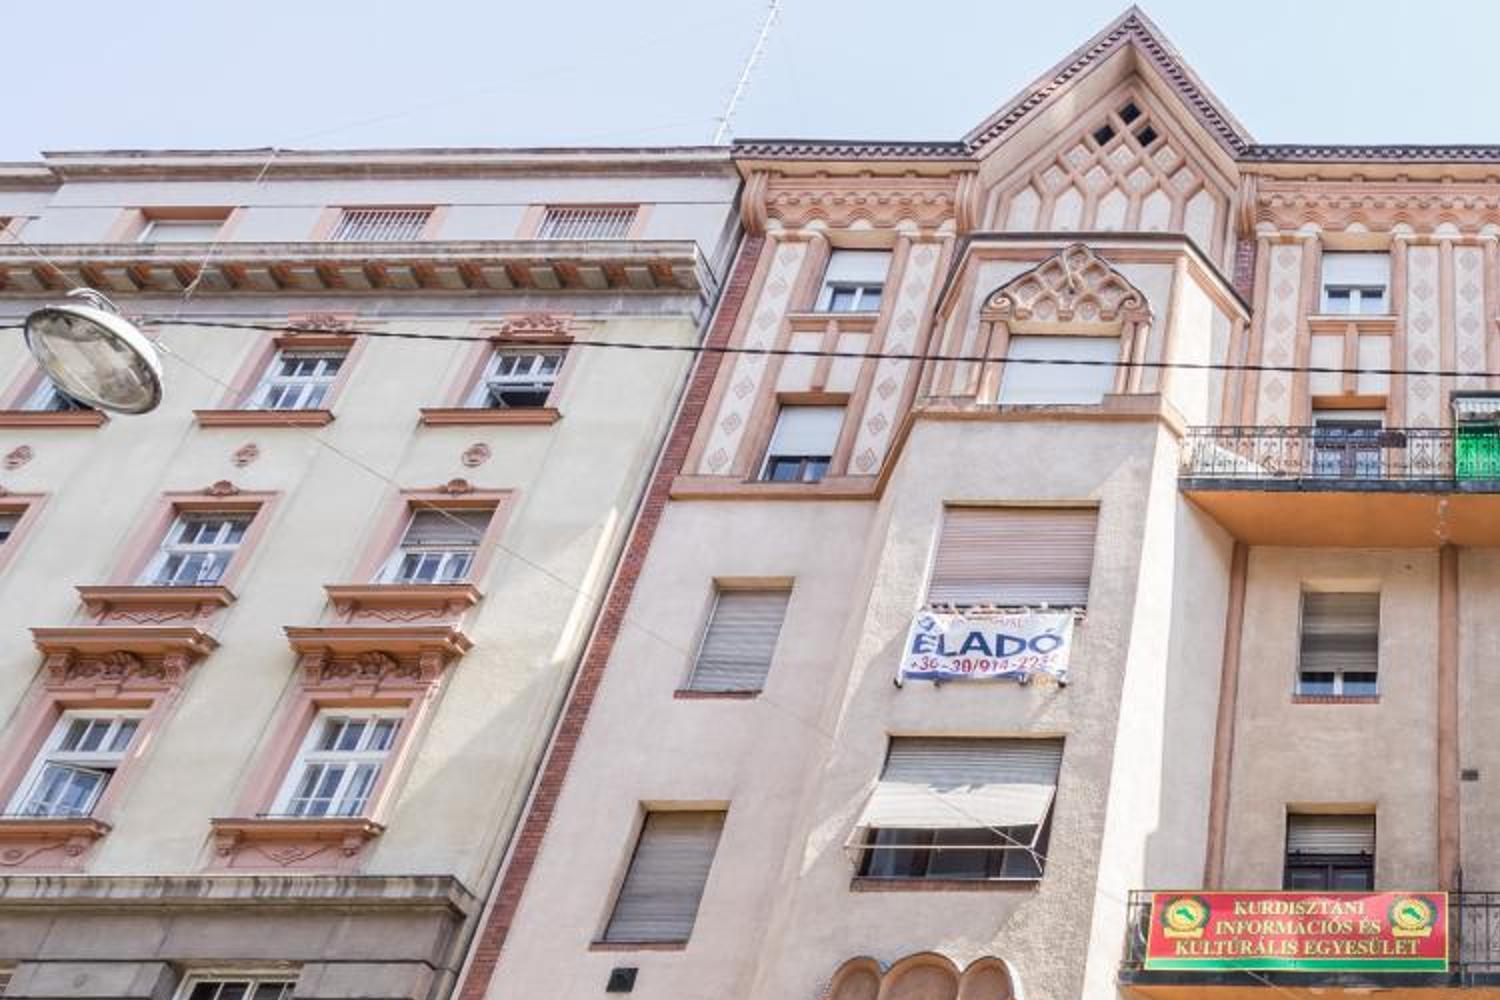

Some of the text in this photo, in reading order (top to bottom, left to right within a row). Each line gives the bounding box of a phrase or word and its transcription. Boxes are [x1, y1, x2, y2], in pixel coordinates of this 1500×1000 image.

[911, 627, 1063, 658] ELADÓ
[1234, 898, 1366, 916] KURDISZTÁNI
[1215, 917, 1381, 935] INFORMÁCIÓS ÉS
[1304, 937, 1420, 956] EGYESÜLET
